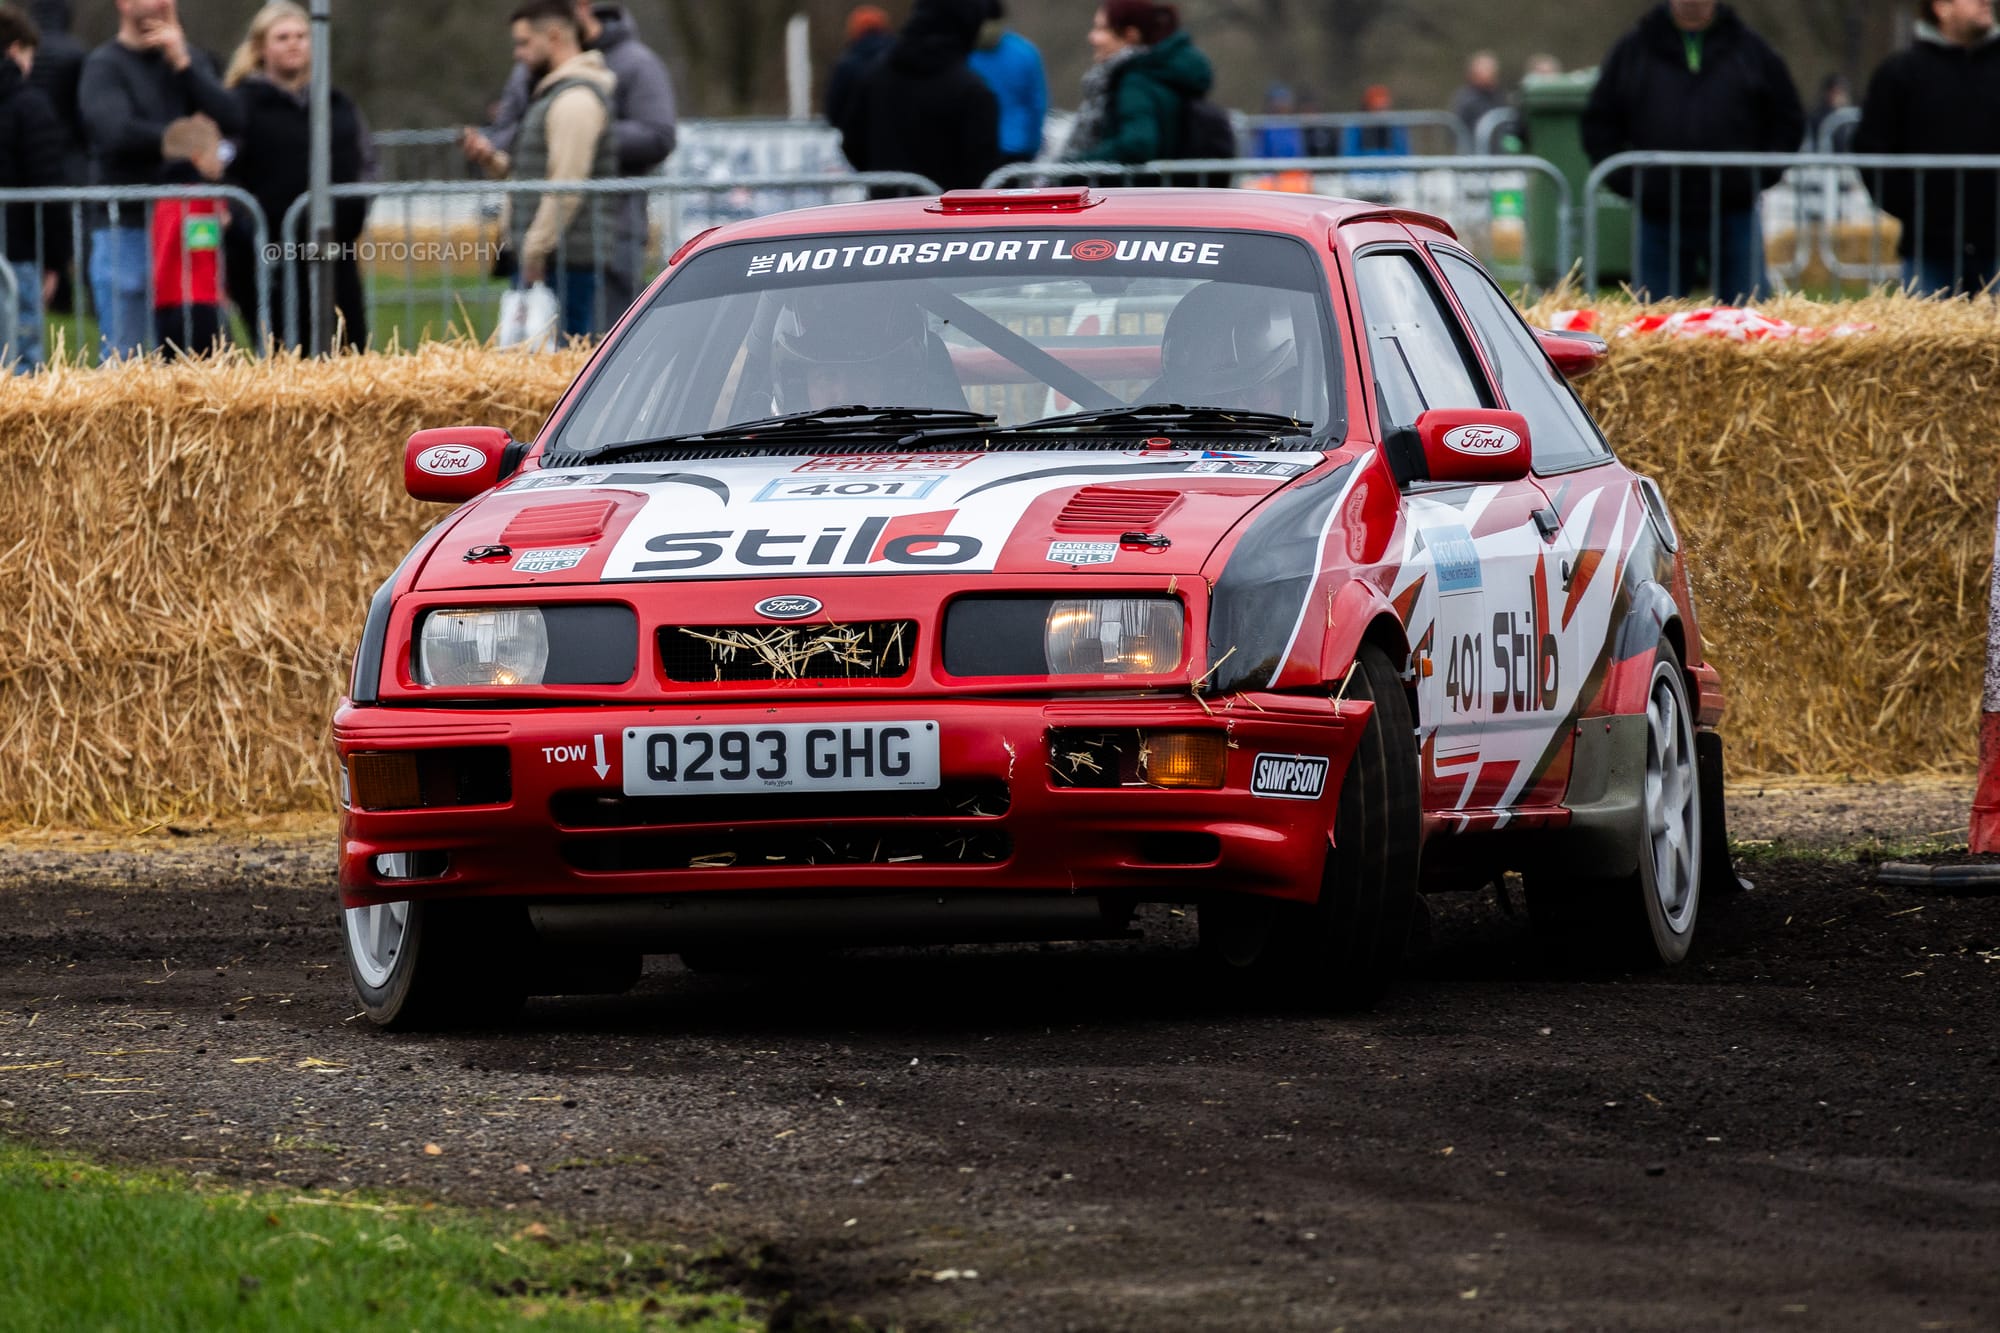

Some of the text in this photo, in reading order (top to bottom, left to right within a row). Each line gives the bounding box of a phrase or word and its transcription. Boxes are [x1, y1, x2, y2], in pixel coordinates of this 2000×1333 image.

[747, 253, 776, 277] THE
[776, 240, 1048, 273] MOTORSPORT
[1461, 428, 1504, 448] Ford
[430, 449, 470, 468] Ford
[787, 482, 905, 496] 401
[527, 549, 584, 558] CARLESS
[1052, 553, 1110, 563] FUELS
[518, 560, 574, 571] FUELS
[766, 600, 810, 612] Ford
[1446, 633, 1483, 713] 401
[542, 744, 587, 763] TOW
[647, 727, 911, 782] Q293 GHG
[1257, 760, 1323, 792] SIMPSON
